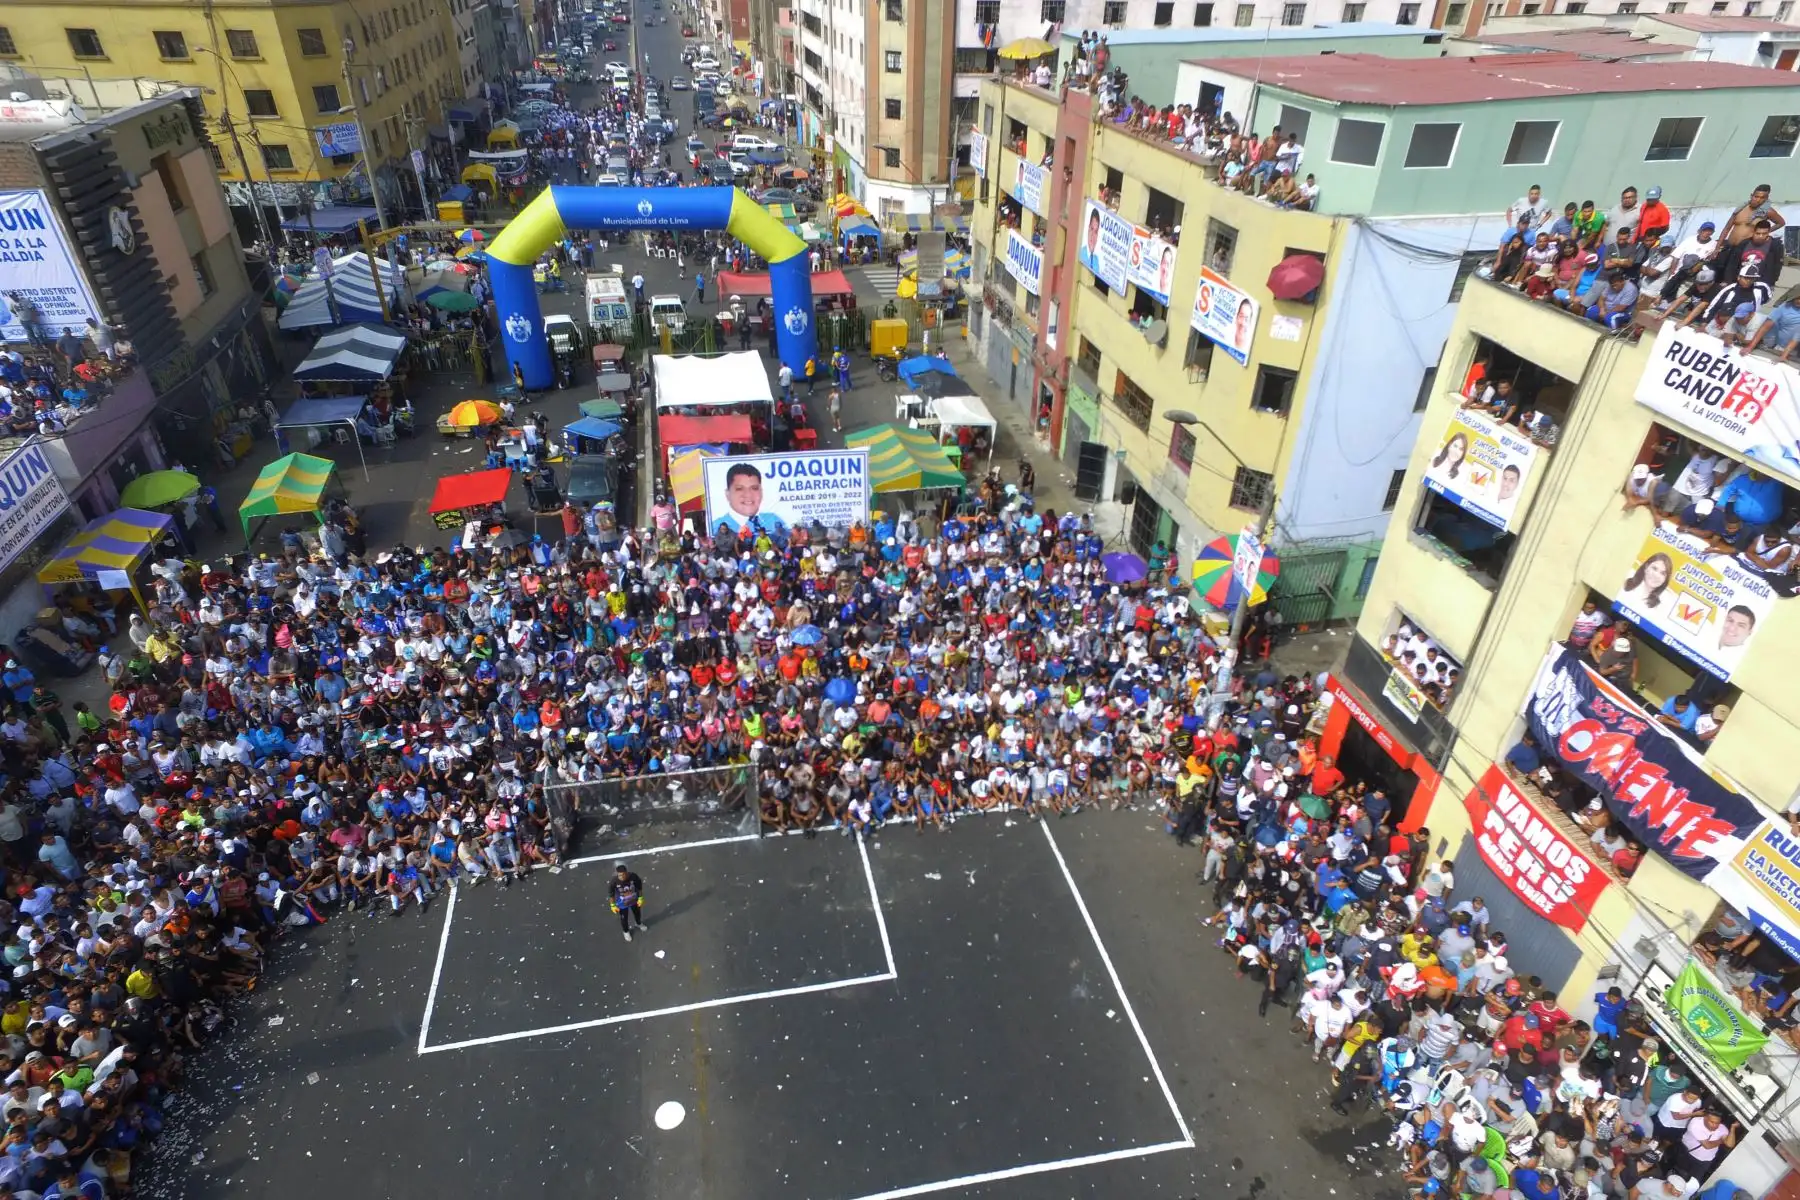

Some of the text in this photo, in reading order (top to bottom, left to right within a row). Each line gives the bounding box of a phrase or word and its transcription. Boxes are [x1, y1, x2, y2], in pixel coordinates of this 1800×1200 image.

[0, 208, 46, 232] UIN
[603, 217, 657, 226] Municipalidad
[669, 217, 689, 225] Lima
[1101, 214, 1130, 246] JOAQUIN
[0, 251, 45, 262] ALDIA
[14, 239, 25, 248] A
[27, 238, 47, 248] LA
[40, 287, 77, 295] DISTRITO
[1664, 340, 1741, 386] RUBÉN
[1664, 367, 1726, 406] CANO
[1683, 401, 1747, 436] A LA VICTORIA
[765, 457, 861, 479] JOAQUIN
[15, 509, 25, 521] EL
[23, 478, 57, 514] MUNDIALITO
[778, 478, 862, 493] ALBARRACIN
[779, 493, 816, 502] ALCALDE
[32, 513, 43, 526] LA
[40, 494, 65, 518] VICTORIA
[1652, 527, 1678, 547] ESTHER
[1722, 566, 1744, 584] RUDY
[1674, 573, 1731, 610] LA VICTORIA
[1682, 563, 1735, 599] JUNTOS POR
[1619, 606, 1642, 625] LIMA
[1334, 687, 1377, 731] LIVESPORT
[1588, 695, 1624, 724] LOS
[1495, 783, 1591, 884] VAMOS
[1483, 809, 1577, 903] PERÚ
[1748, 849, 1766, 869] LA
[1744, 860, 1756, 871] TE
[1755, 869, 1788, 899] QUIERO
